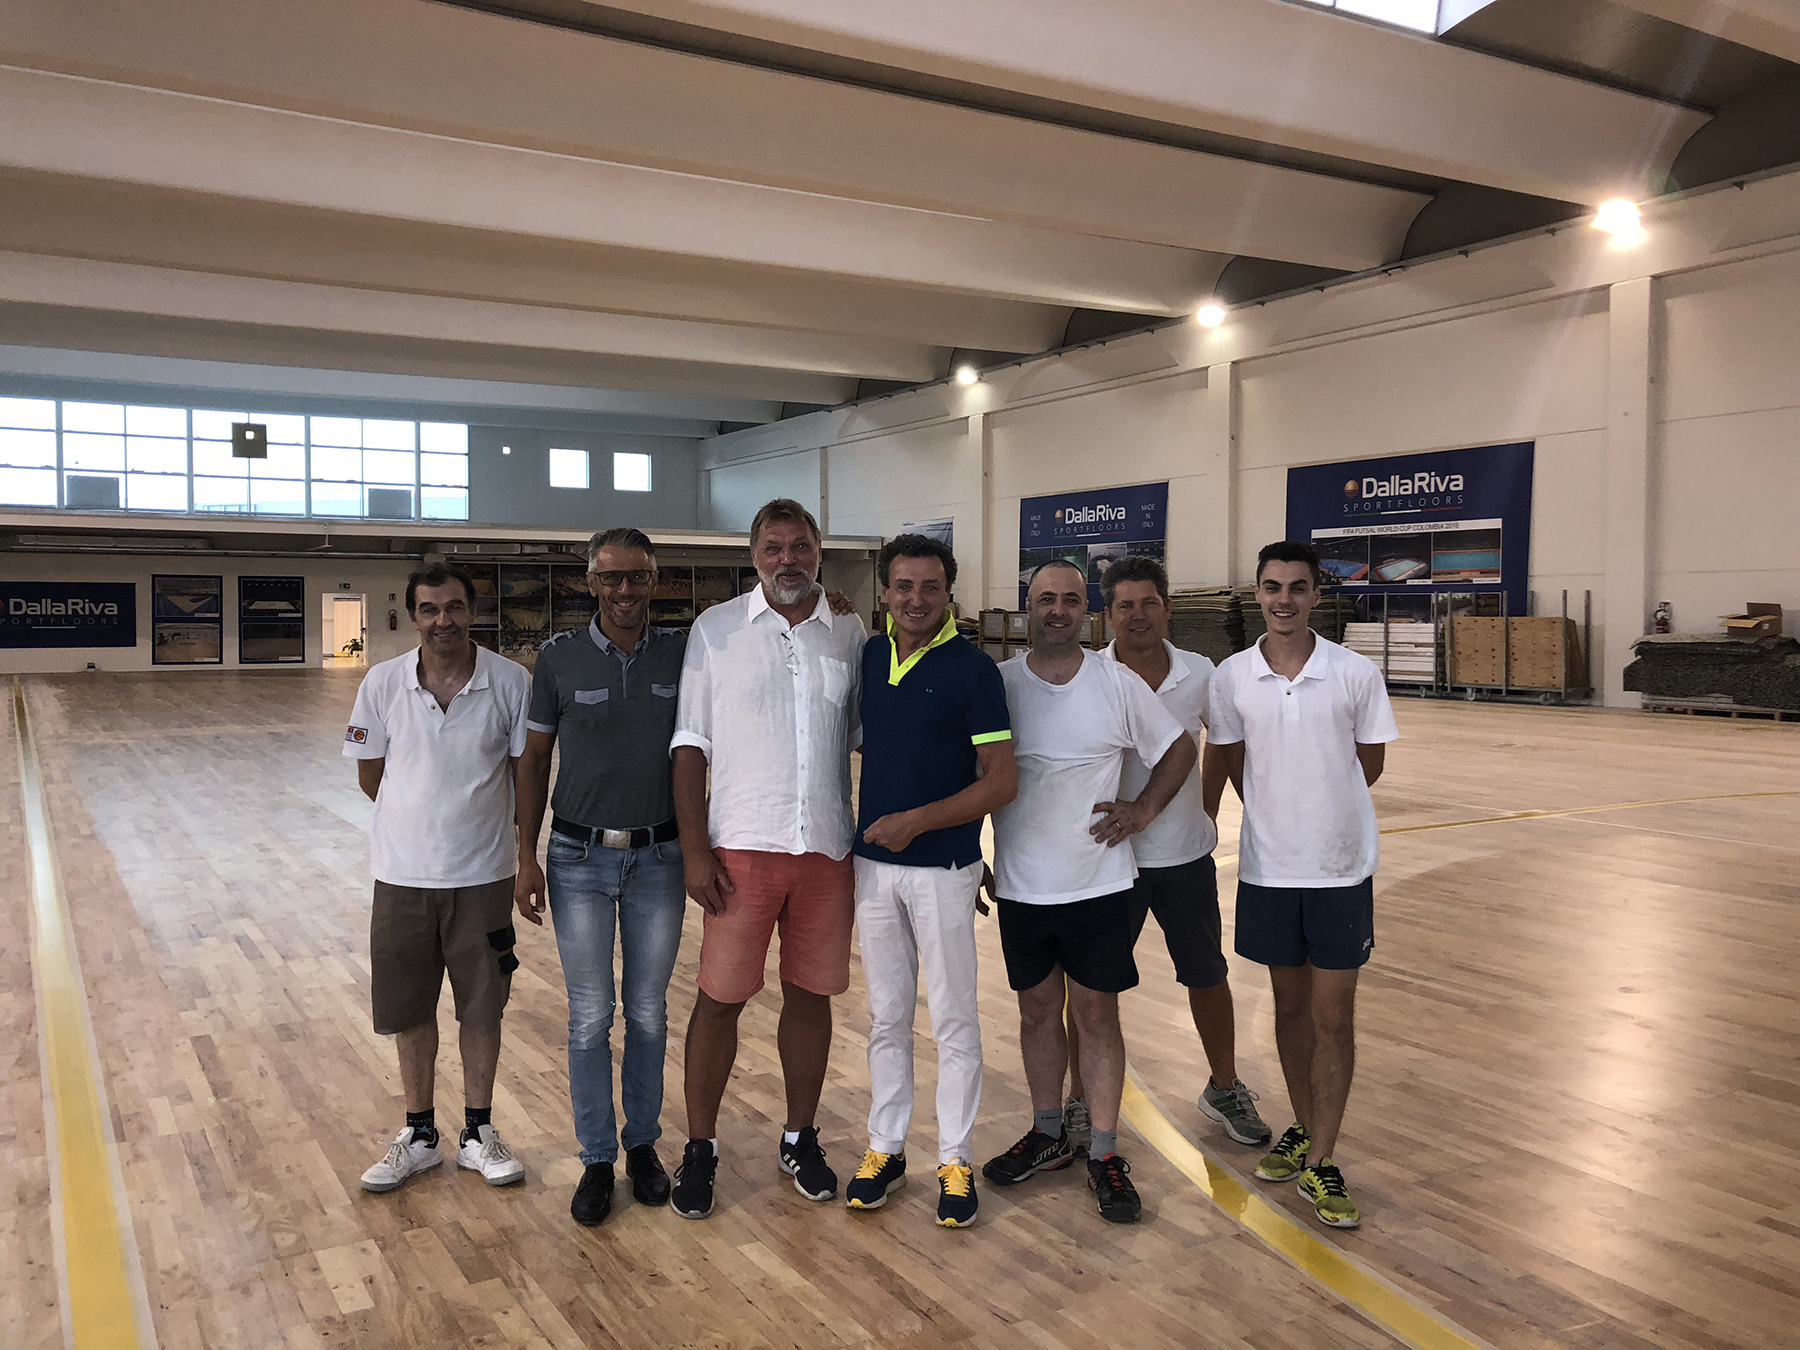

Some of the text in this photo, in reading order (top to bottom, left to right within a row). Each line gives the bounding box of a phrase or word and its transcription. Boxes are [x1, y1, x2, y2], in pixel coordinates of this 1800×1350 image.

[1362, 472, 1464, 499] DallaRiva
[1343, 495, 1464, 513] SPORTFLOORS
[1065, 504, 1126, 524] DallaRiva
[1053, 522, 1126, 535] SPORTFLOORS
[1343, 527, 1355, 535] FIFA
[1377, 525, 1398, 533] WORLD
[1413, 523, 1444, 531] COLOMBIA
[9, 598, 118, 615] DallaRiva
